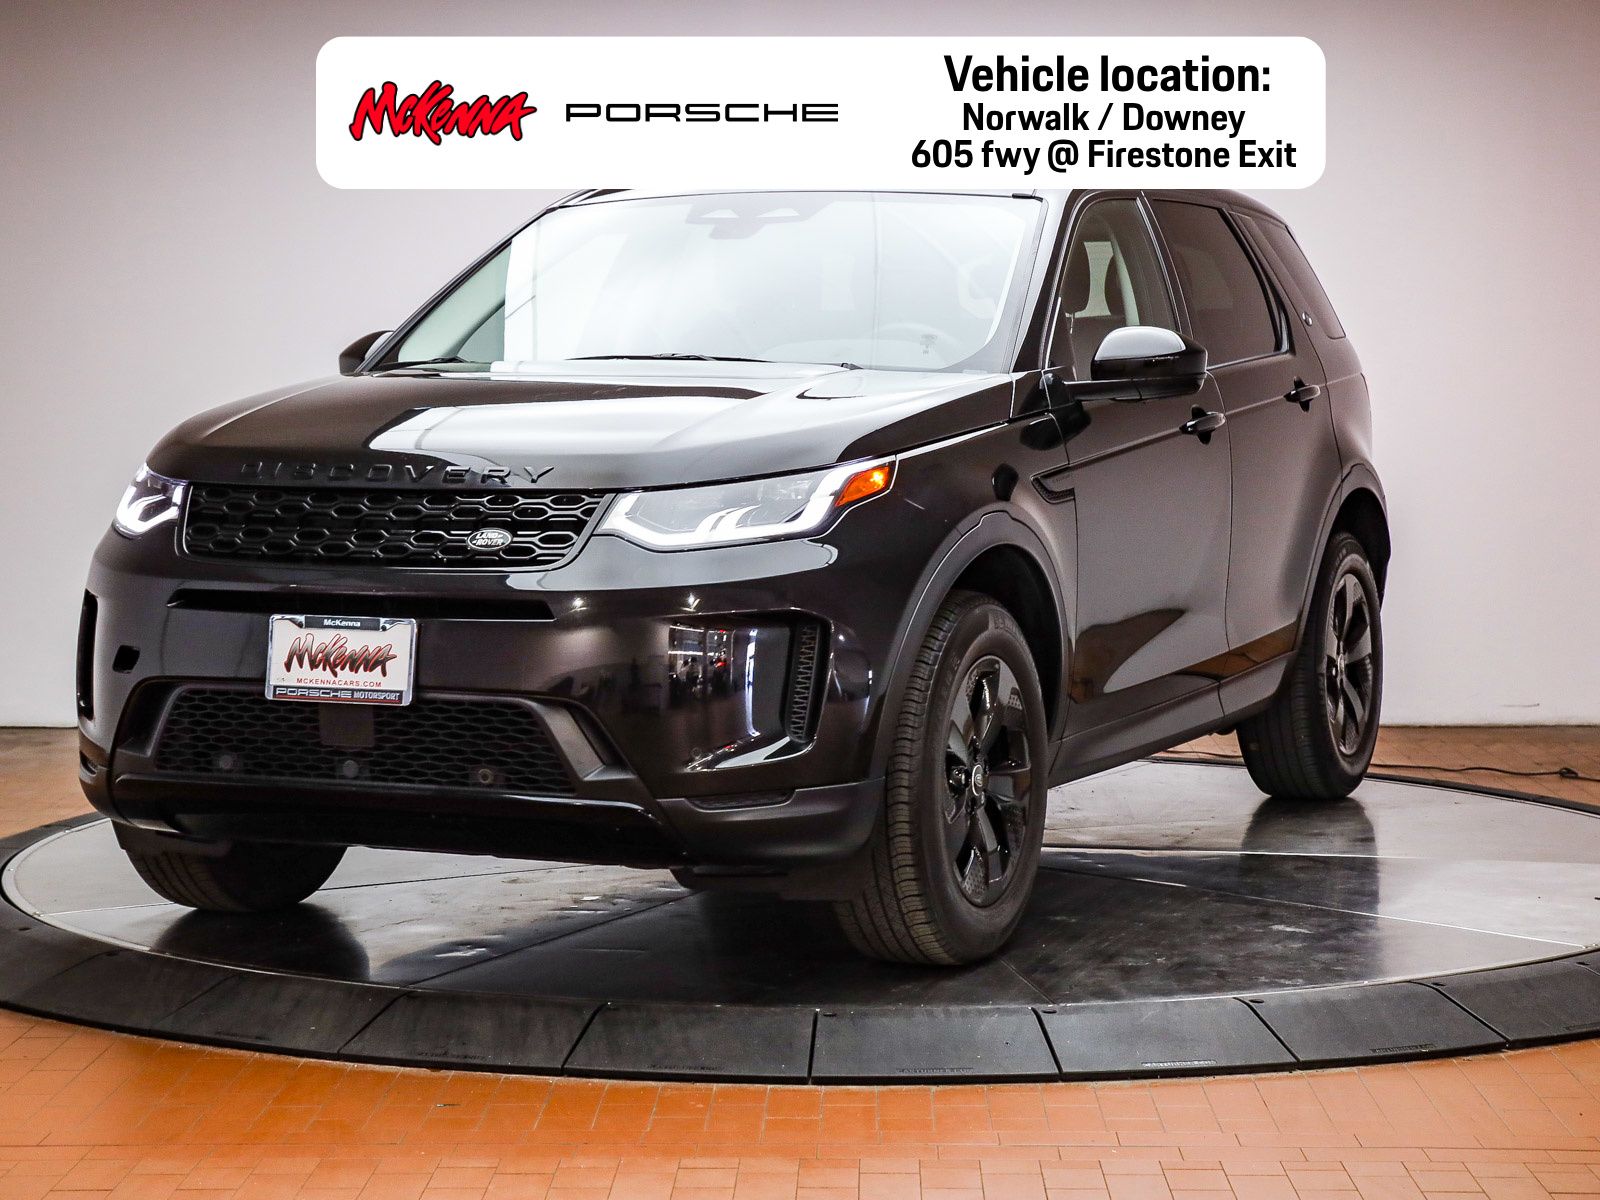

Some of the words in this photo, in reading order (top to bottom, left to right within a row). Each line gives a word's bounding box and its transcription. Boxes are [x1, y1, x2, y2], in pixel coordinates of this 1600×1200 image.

[240, 461, 555, 484] DISCOVERY
[475, 538, 504, 546] ROVER
[323, 618, 362, 628] McKenna
[296, 677, 382, 688] MCKENNACARS.COM
[275, 687, 353, 699] PORSCHE
[353, 691, 400, 701] MOTORSPORT
